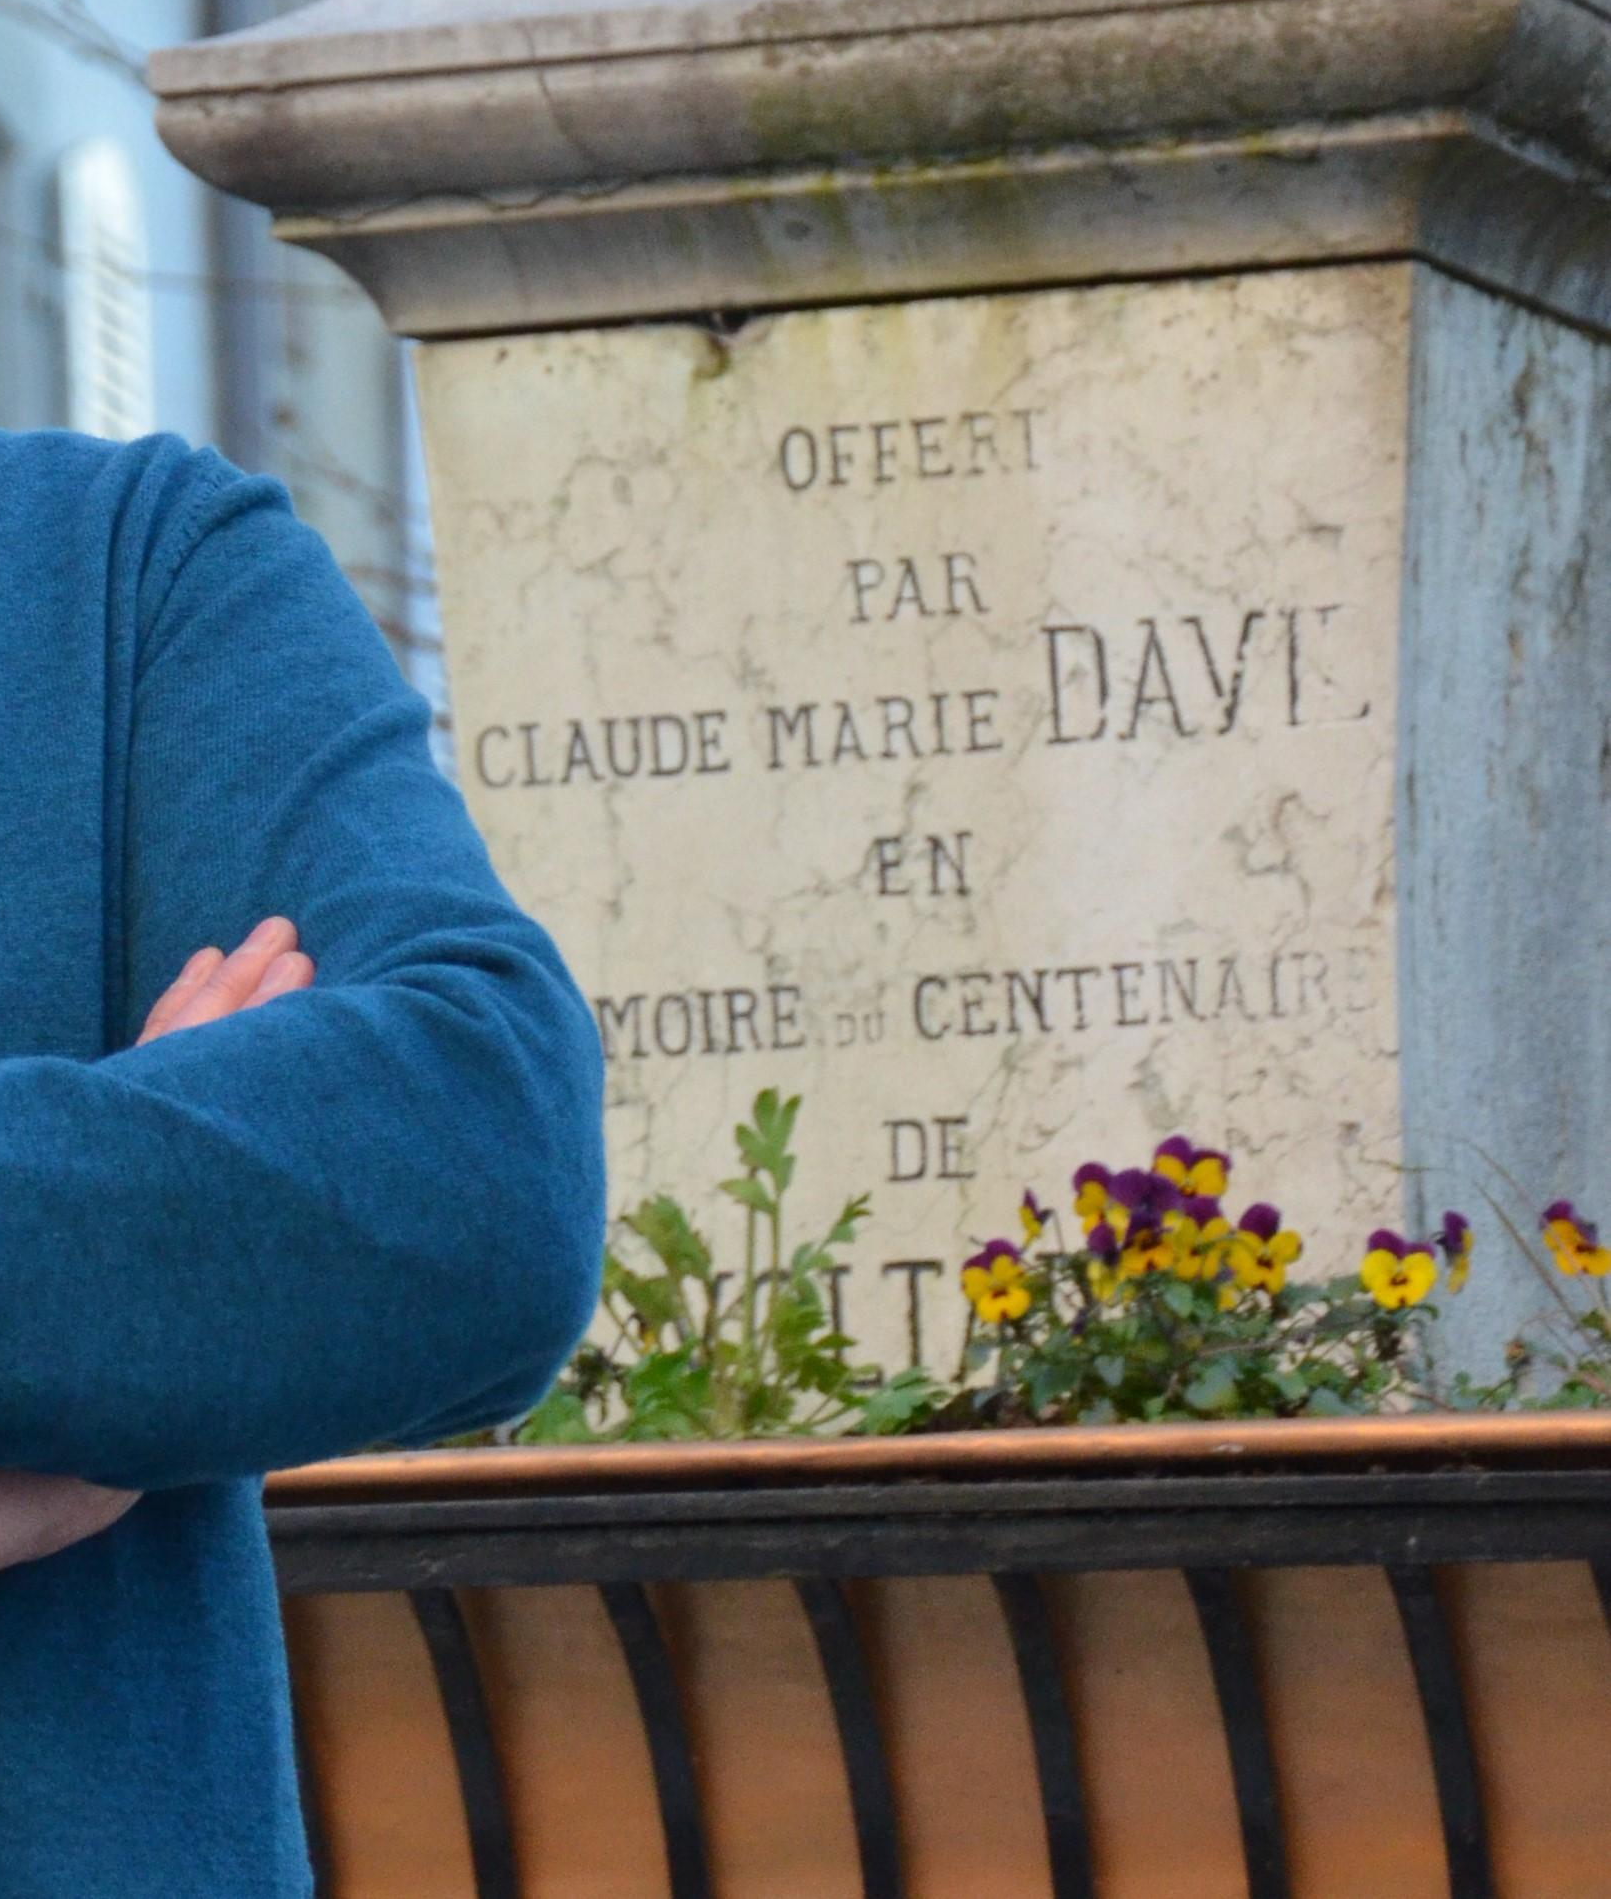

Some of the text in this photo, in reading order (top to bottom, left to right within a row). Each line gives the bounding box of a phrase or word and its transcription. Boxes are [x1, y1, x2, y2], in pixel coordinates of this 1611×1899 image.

[780, 407, 1046, 492] OFFERT
[846, 551, 990, 624] PAR
[476, 709, 731, 789] CLAUDE
[766, 689, 1004, 771] MARIE
[872, 831, 973, 897] EN
[835, 1011, 886, 1048] DU
[913, 946, 1379, 1041] CENTENAIRE
[883, 1116, 977, 1182] DE
